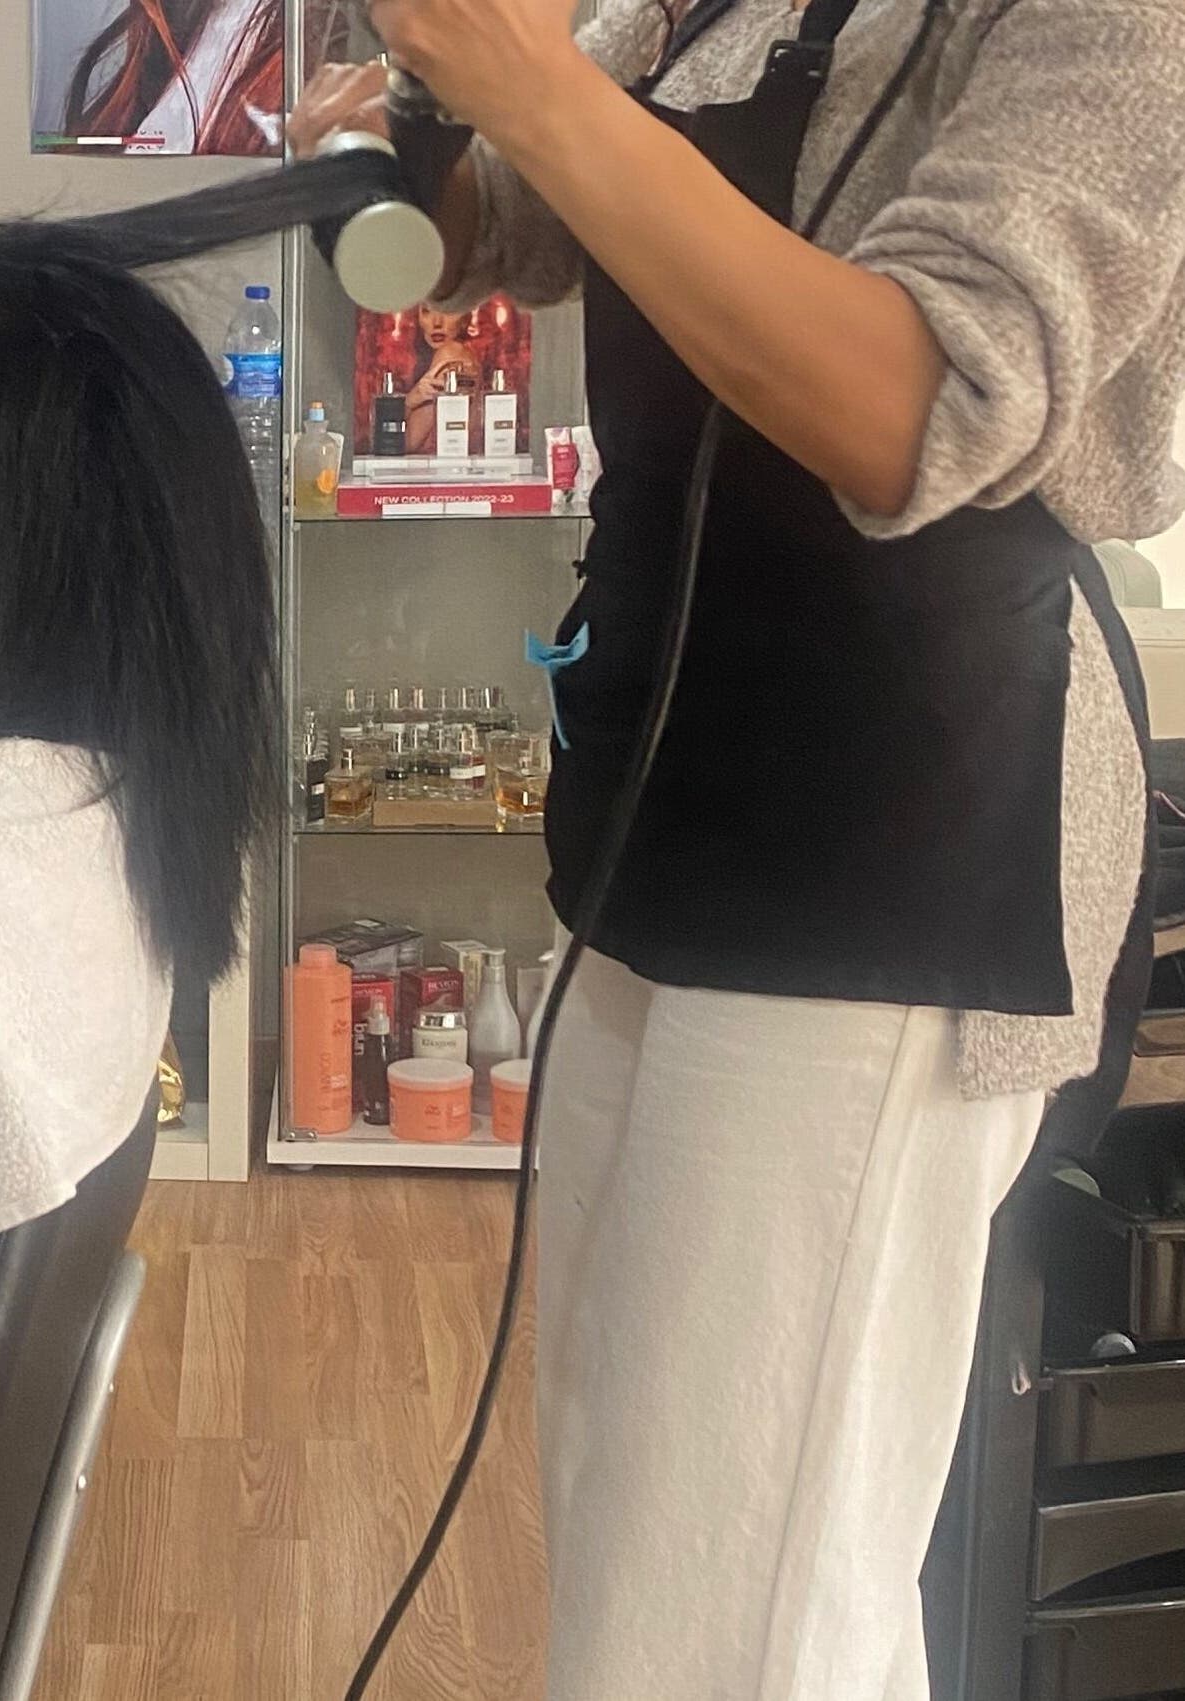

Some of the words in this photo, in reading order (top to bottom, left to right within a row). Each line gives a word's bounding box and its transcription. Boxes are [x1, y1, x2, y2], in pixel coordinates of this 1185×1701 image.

[374, 496, 398, 504] NEW
[401, 495, 469, 504] COLLECTION
[470, 494, 515, 503] 2022-23
